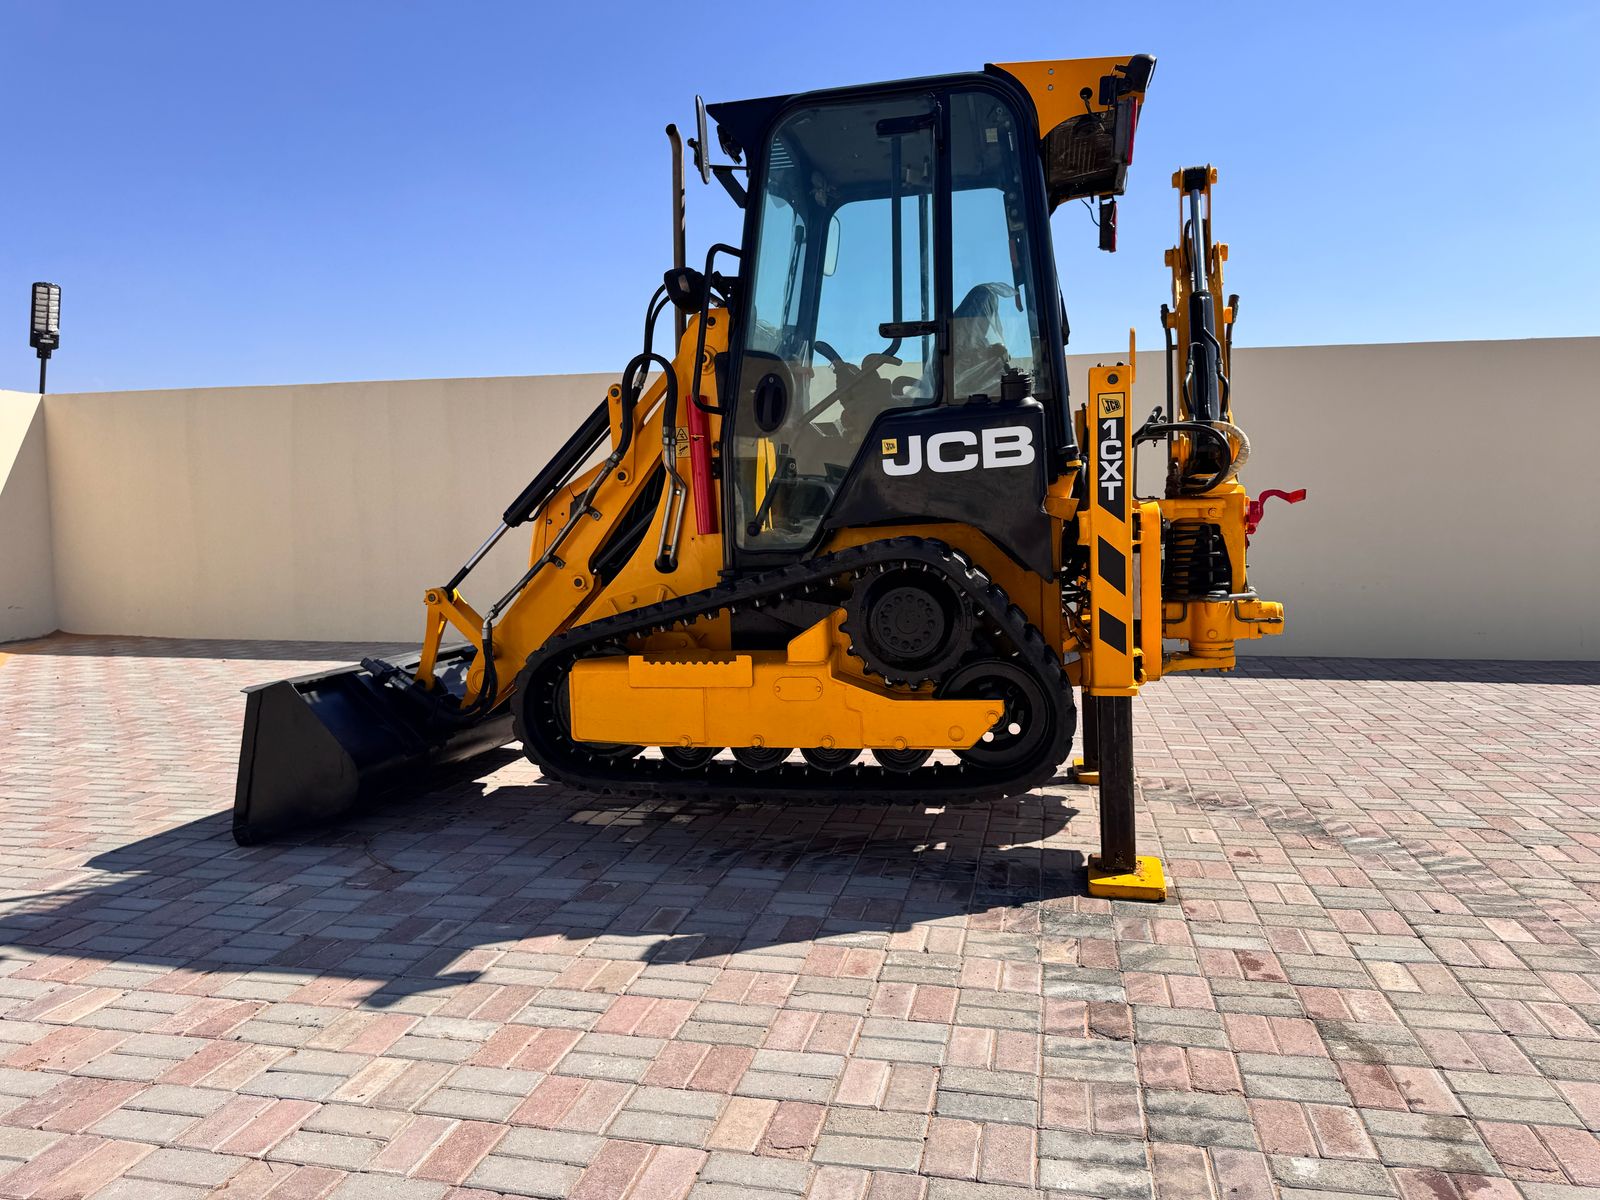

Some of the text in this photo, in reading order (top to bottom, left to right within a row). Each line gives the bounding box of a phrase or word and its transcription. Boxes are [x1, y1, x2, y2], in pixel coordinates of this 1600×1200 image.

[1102, 398, 1121, 414] JCB
[882, 425, 1036, 477] JCB
[1099, 419, 1123, 501] 1CXT
